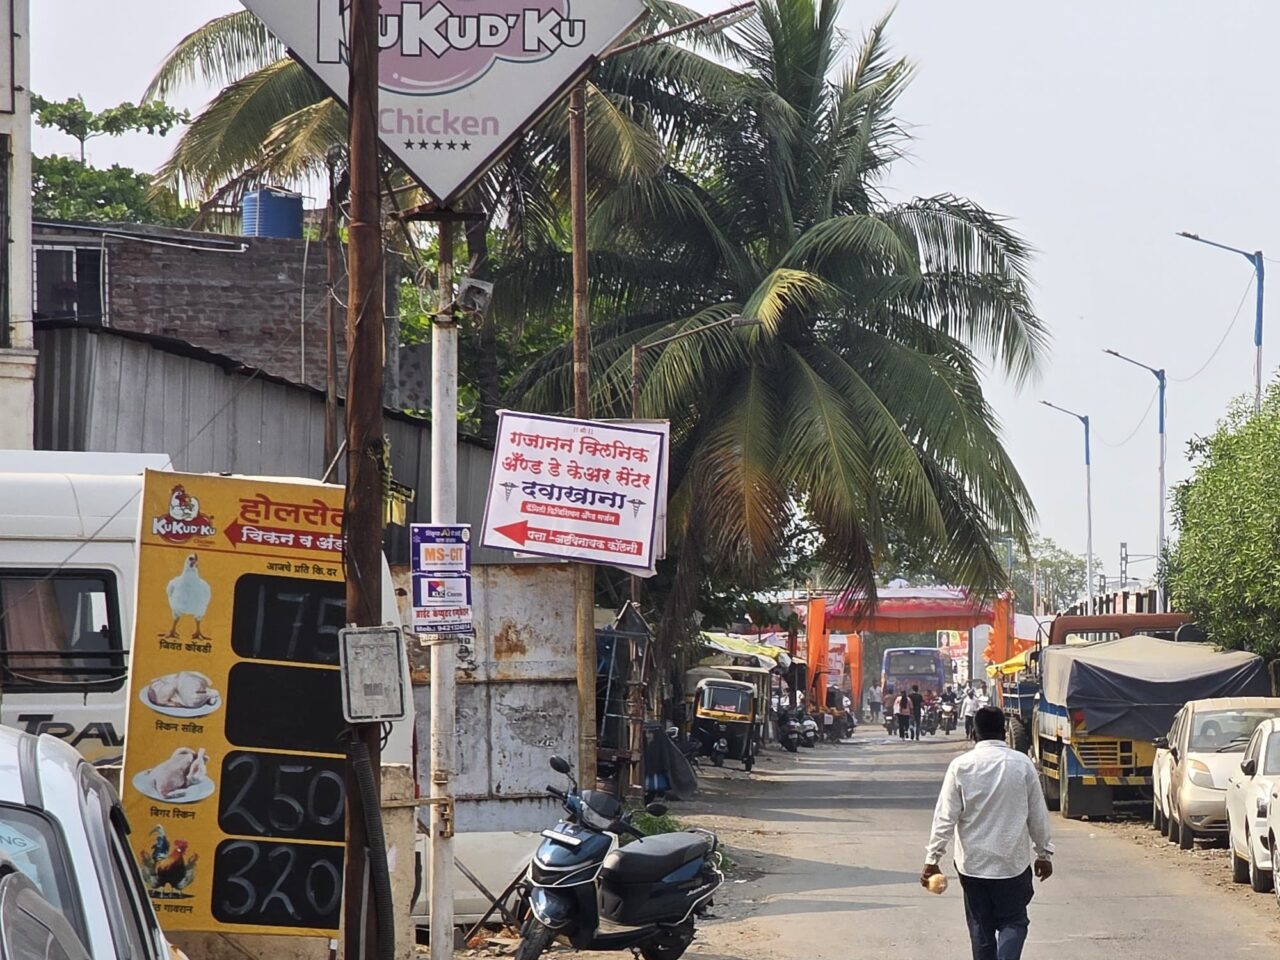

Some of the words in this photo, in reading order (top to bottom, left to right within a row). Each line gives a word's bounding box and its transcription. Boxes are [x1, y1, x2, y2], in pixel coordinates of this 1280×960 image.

[522, 8, 586, 54] KU
[378, 107, 500, 136] Chicken
[510, 431, 575, 452] गजानन
[578, 436, 650, 464] क्लिनिक
[548, 458, 562, 477] डे
[566, 461, 611, 484] केअर
[615, 466, 652, 490] सेंटर
[521, 481, 627, 510] दवाखाना
[241, 526, 296, 546] चिकन
[299, 535, 314, 548] व
[266, 561, 292, 572] आजचे
[294, 563, 311, 575] प्रति
[326, 568, 339, 577] दर
[424, 547, 464, 562] MS-CIT
[155, 719, 178, 732] स्किन
[223, 754, 345, 835] 250
[172, 808, 196, 820] स्किन
[221, 841, 342, 921] 320
